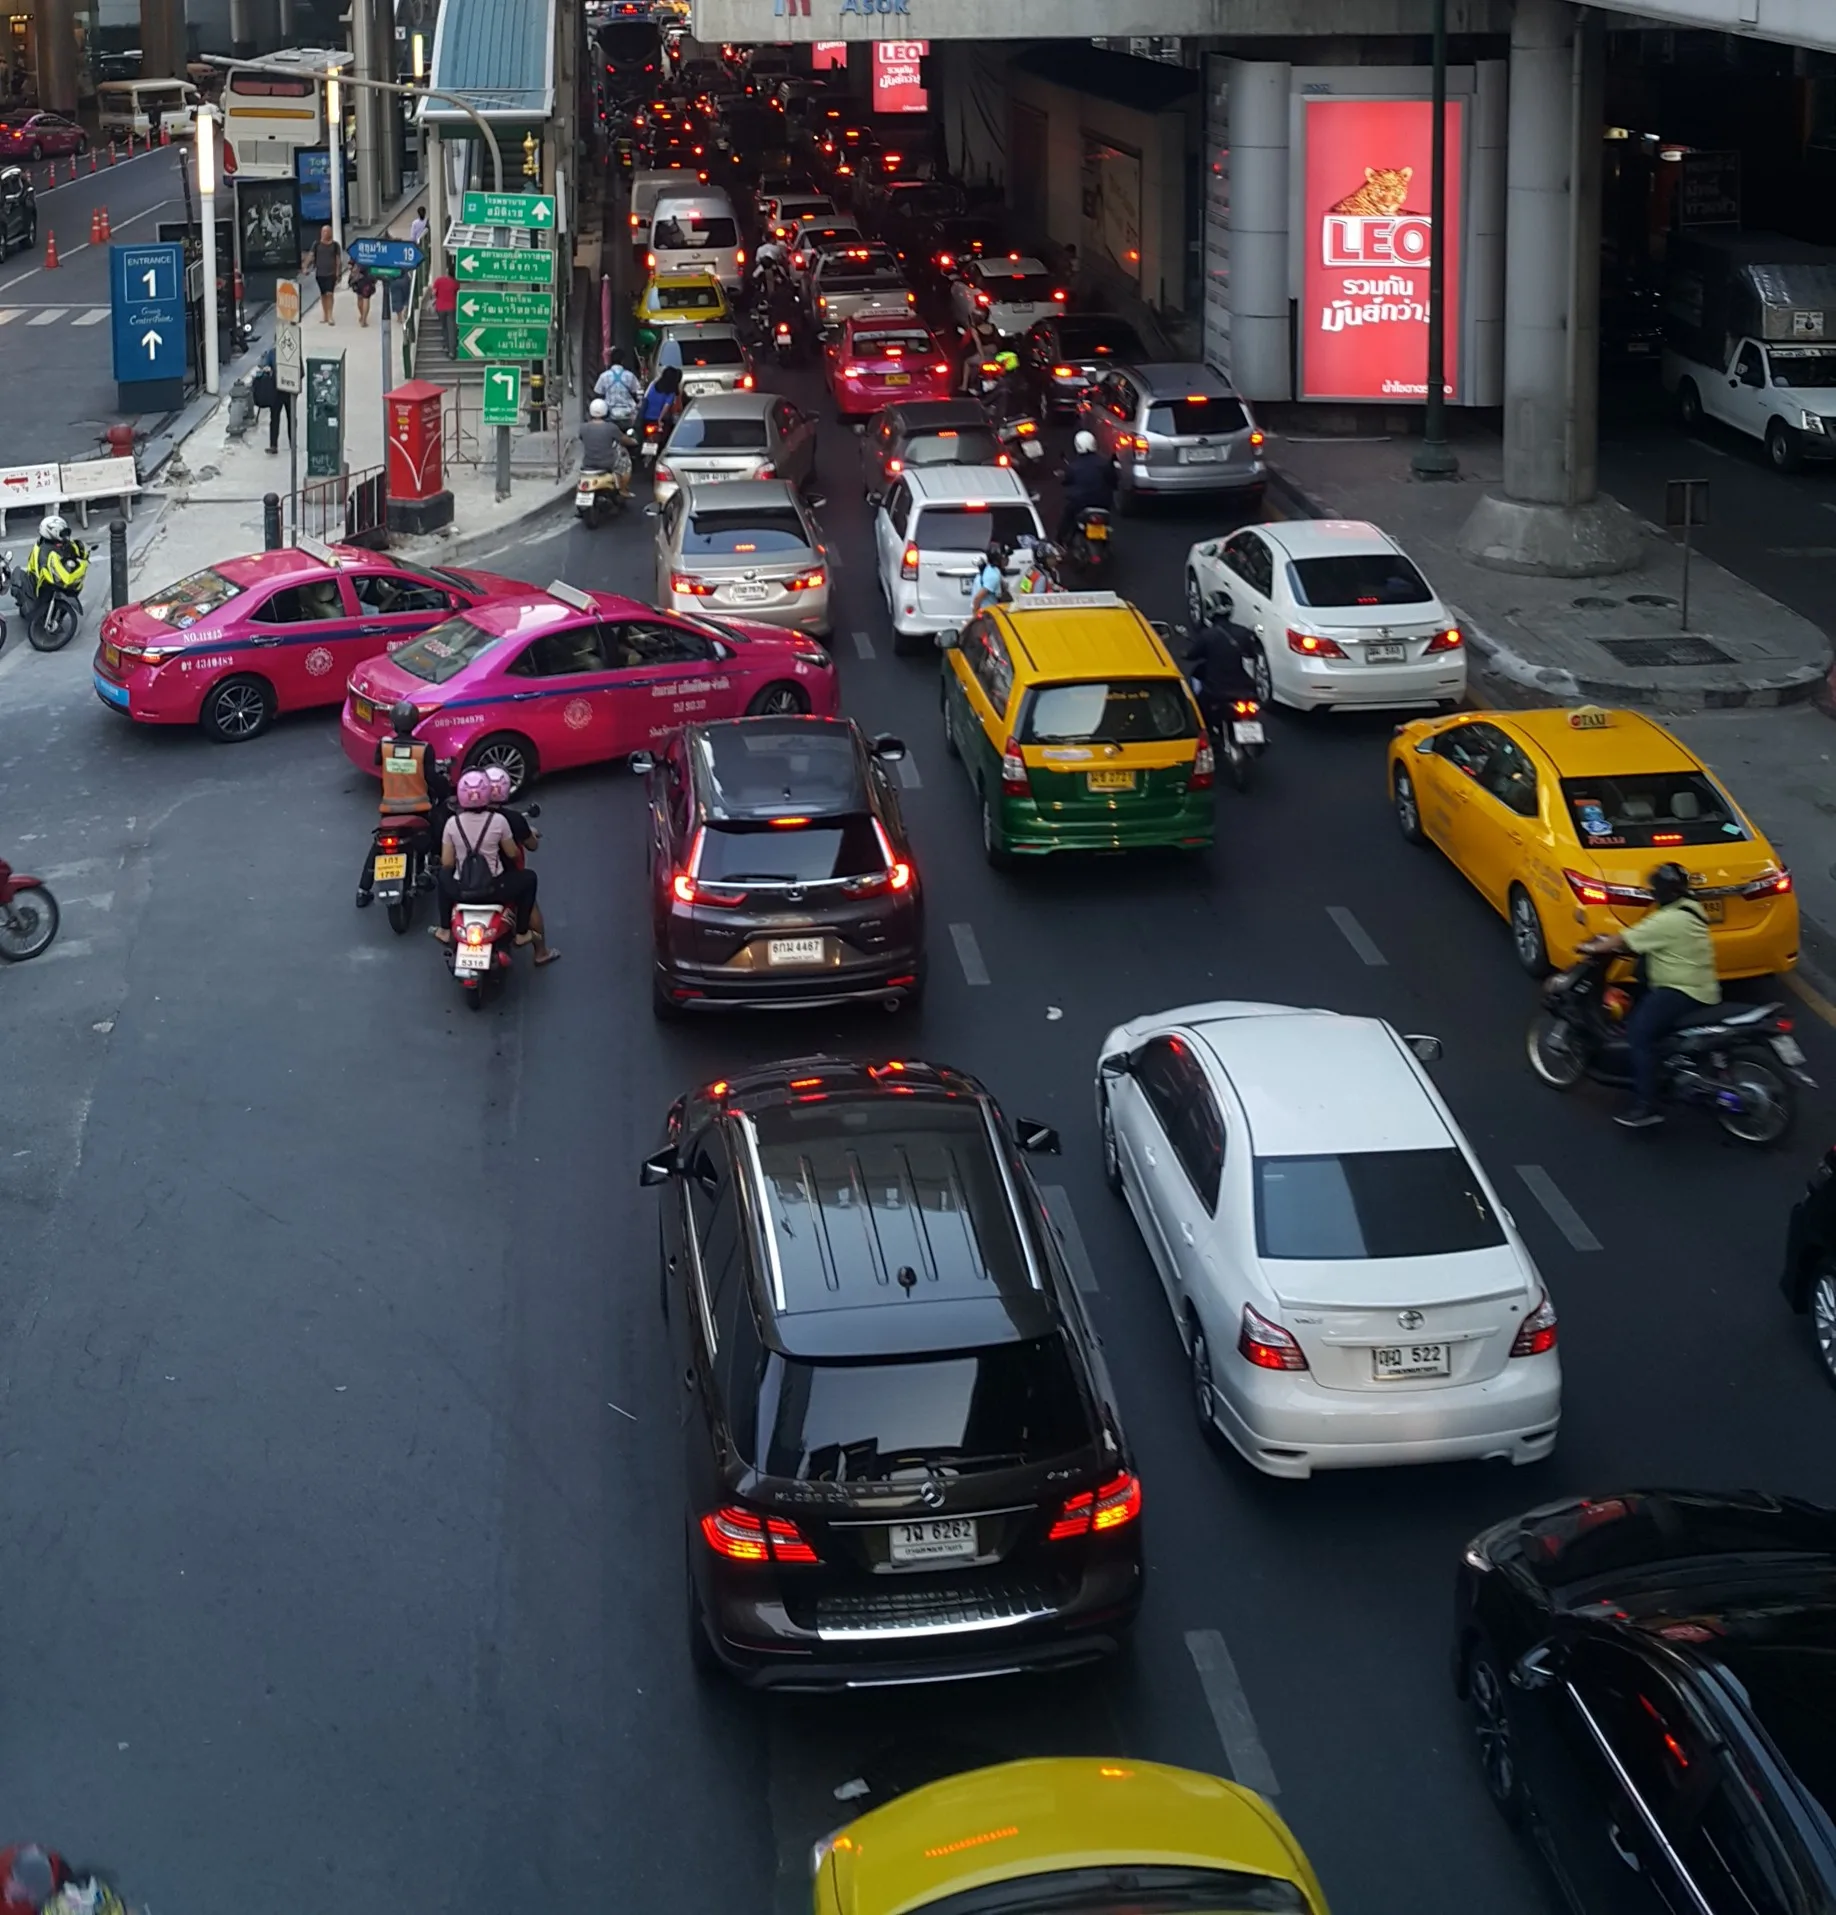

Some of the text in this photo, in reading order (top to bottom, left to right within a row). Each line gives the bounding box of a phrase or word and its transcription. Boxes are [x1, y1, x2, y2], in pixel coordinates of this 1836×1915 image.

[881, 45, 920, 62] LEO
[1329, 218, 1431, 264] LEO
[128, 256, 171, 266] ENTRANCE
[403, 247, 415, 260] 19
[142, 268, 156, 297] 1
[1343, 275, 1414, 296] รวมกัน
[1581, 713, 1606, 726] TAXI
[796, 940, 820, 951] 4467
[1412, 1346, 1441, 1362] 522
[932, 1520, 972, 1539] 6262
